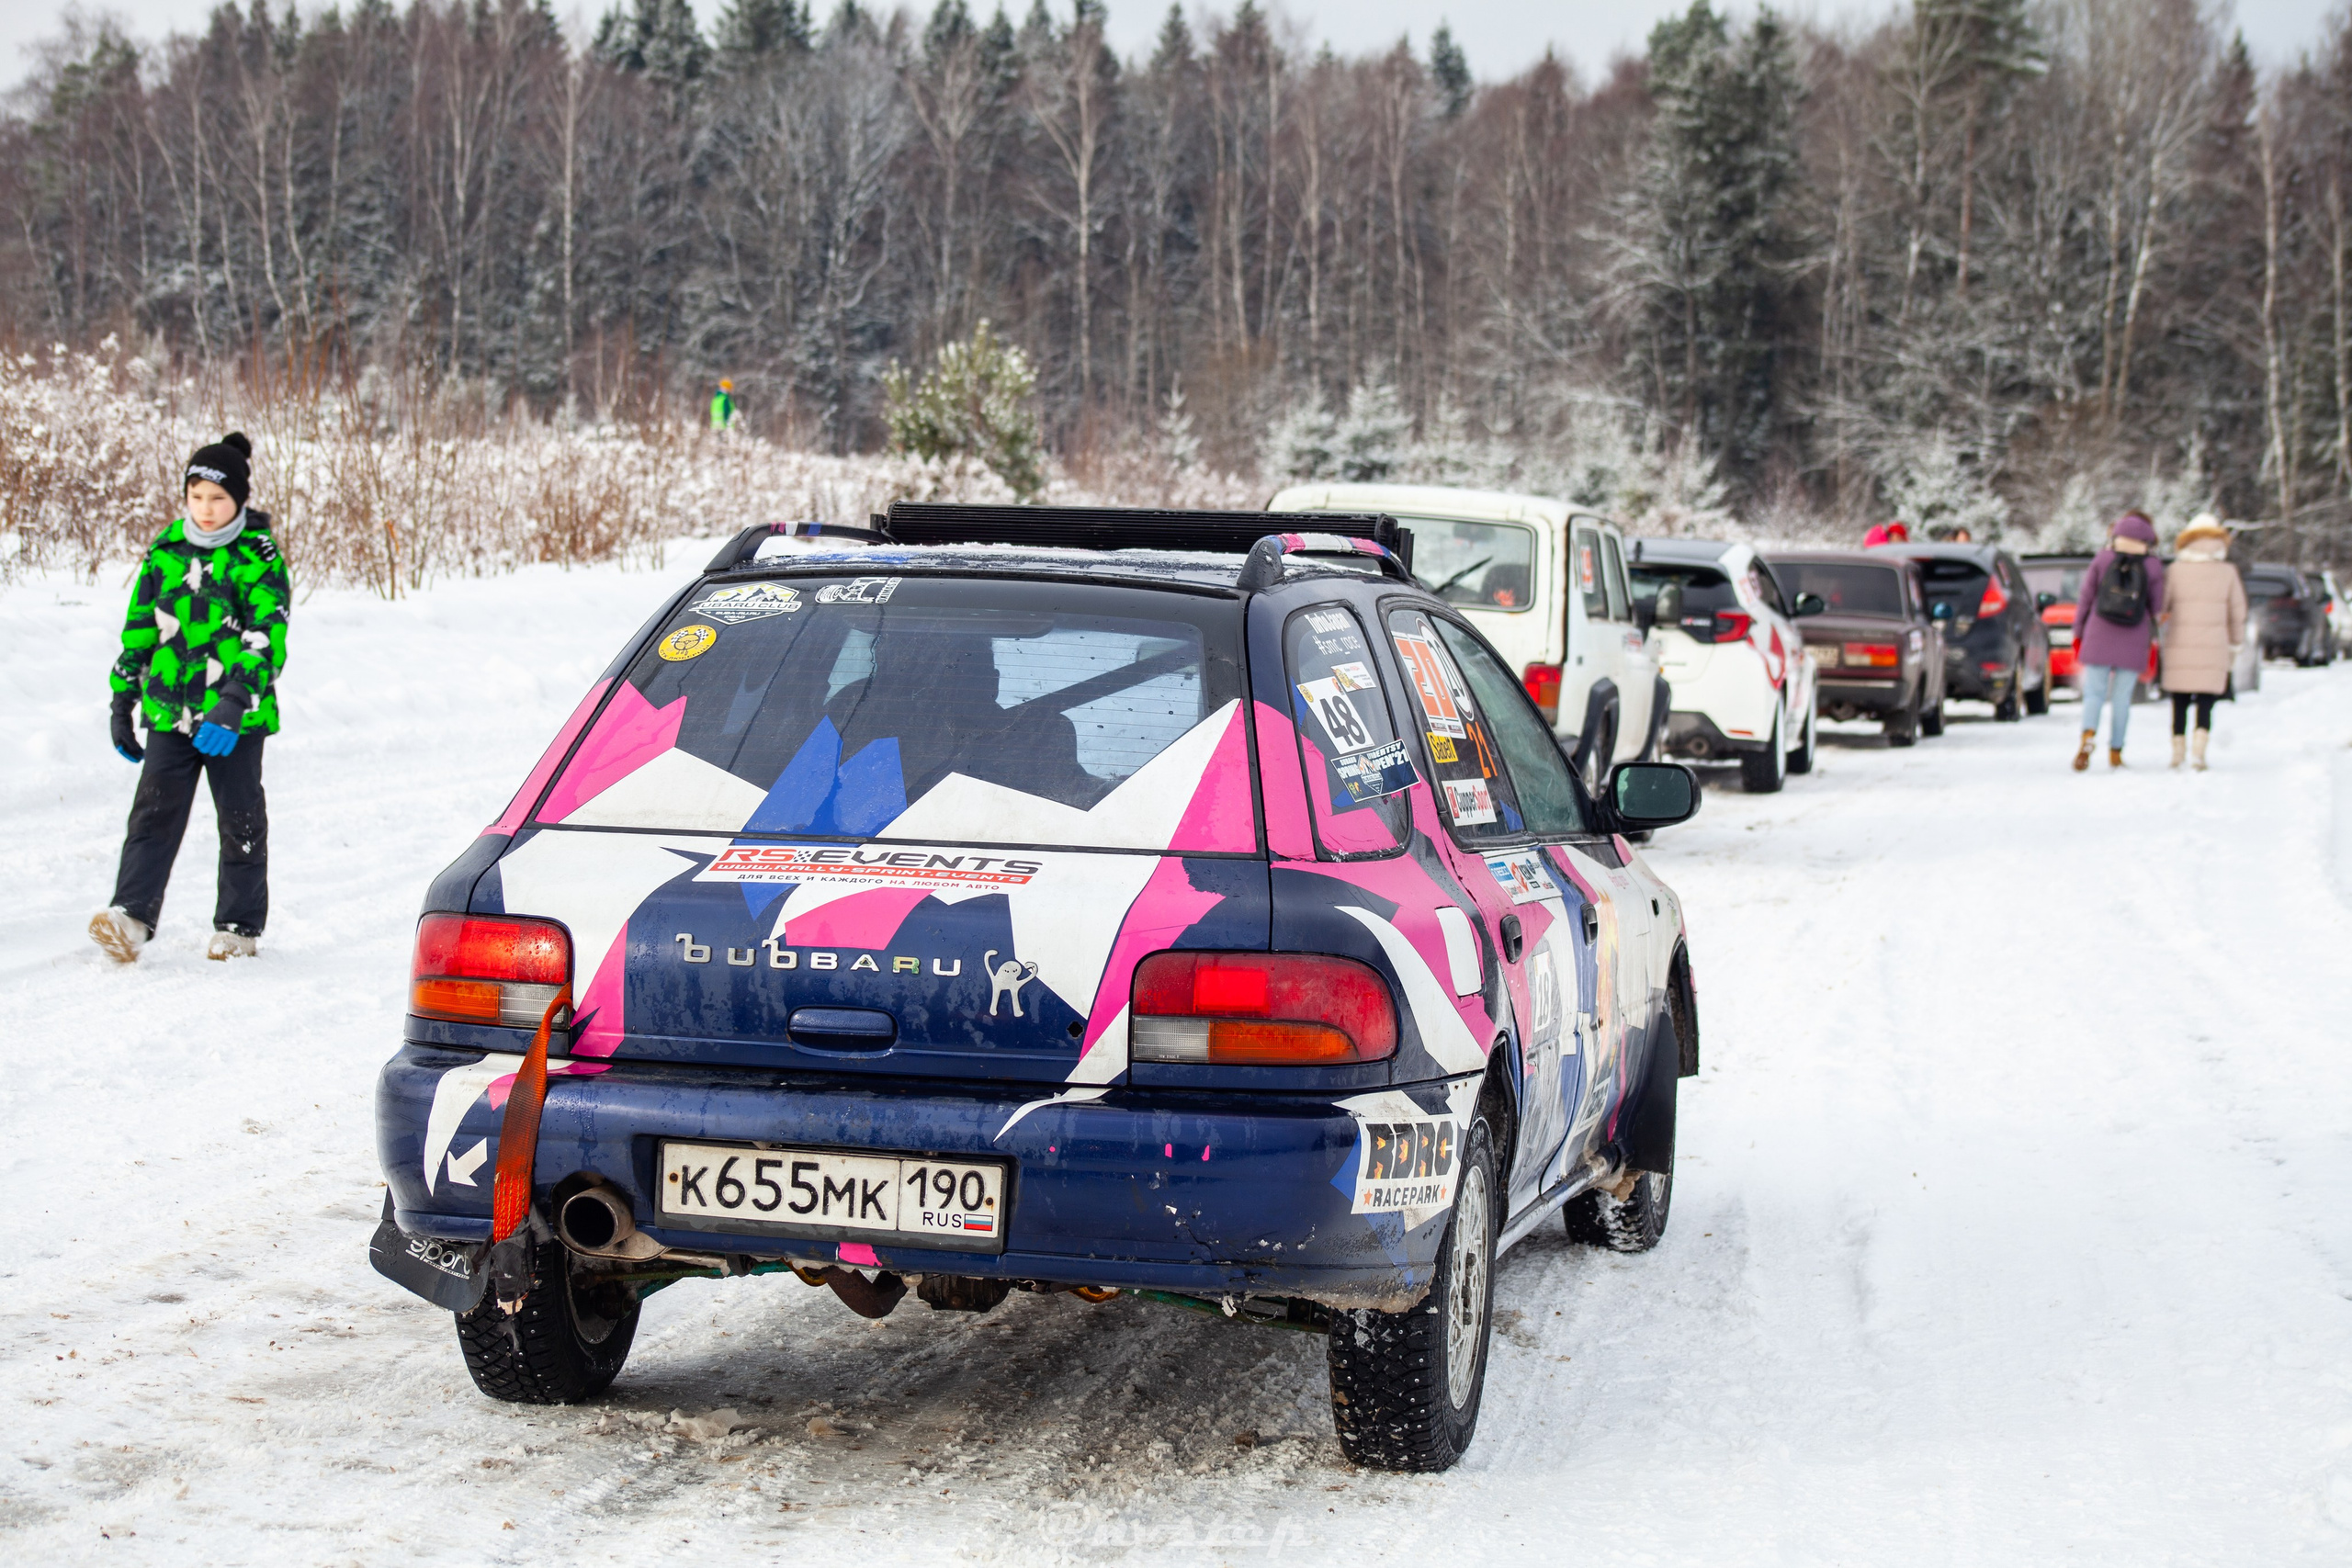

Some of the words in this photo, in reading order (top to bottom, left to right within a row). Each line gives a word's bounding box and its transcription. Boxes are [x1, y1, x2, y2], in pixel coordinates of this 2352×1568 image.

[1394, 637, 1459, 718] 20
[1319, 694, 1366, 747] 48
[1465, 721, 1498, 779] 21
[717, 863, 1024, 883] WWW.RALLY-SPRINT.EVENTS
[718, 849, 797, 863] RS
[809, 850, 1044, 874] EVENTS
[820, 876, 883, 885] КАЖДОГО
[911, 880, 960, 888] ЛЮБОМ
[966, 883, 1000, 891] АВТО
[1365, 1121, 1454, 1179] RDRC
[905, 1167, 985, 1210] 190
[1372, 1184, 1441, 1207] RACEPARK
[922, 1211, 962, 1228] RUS
